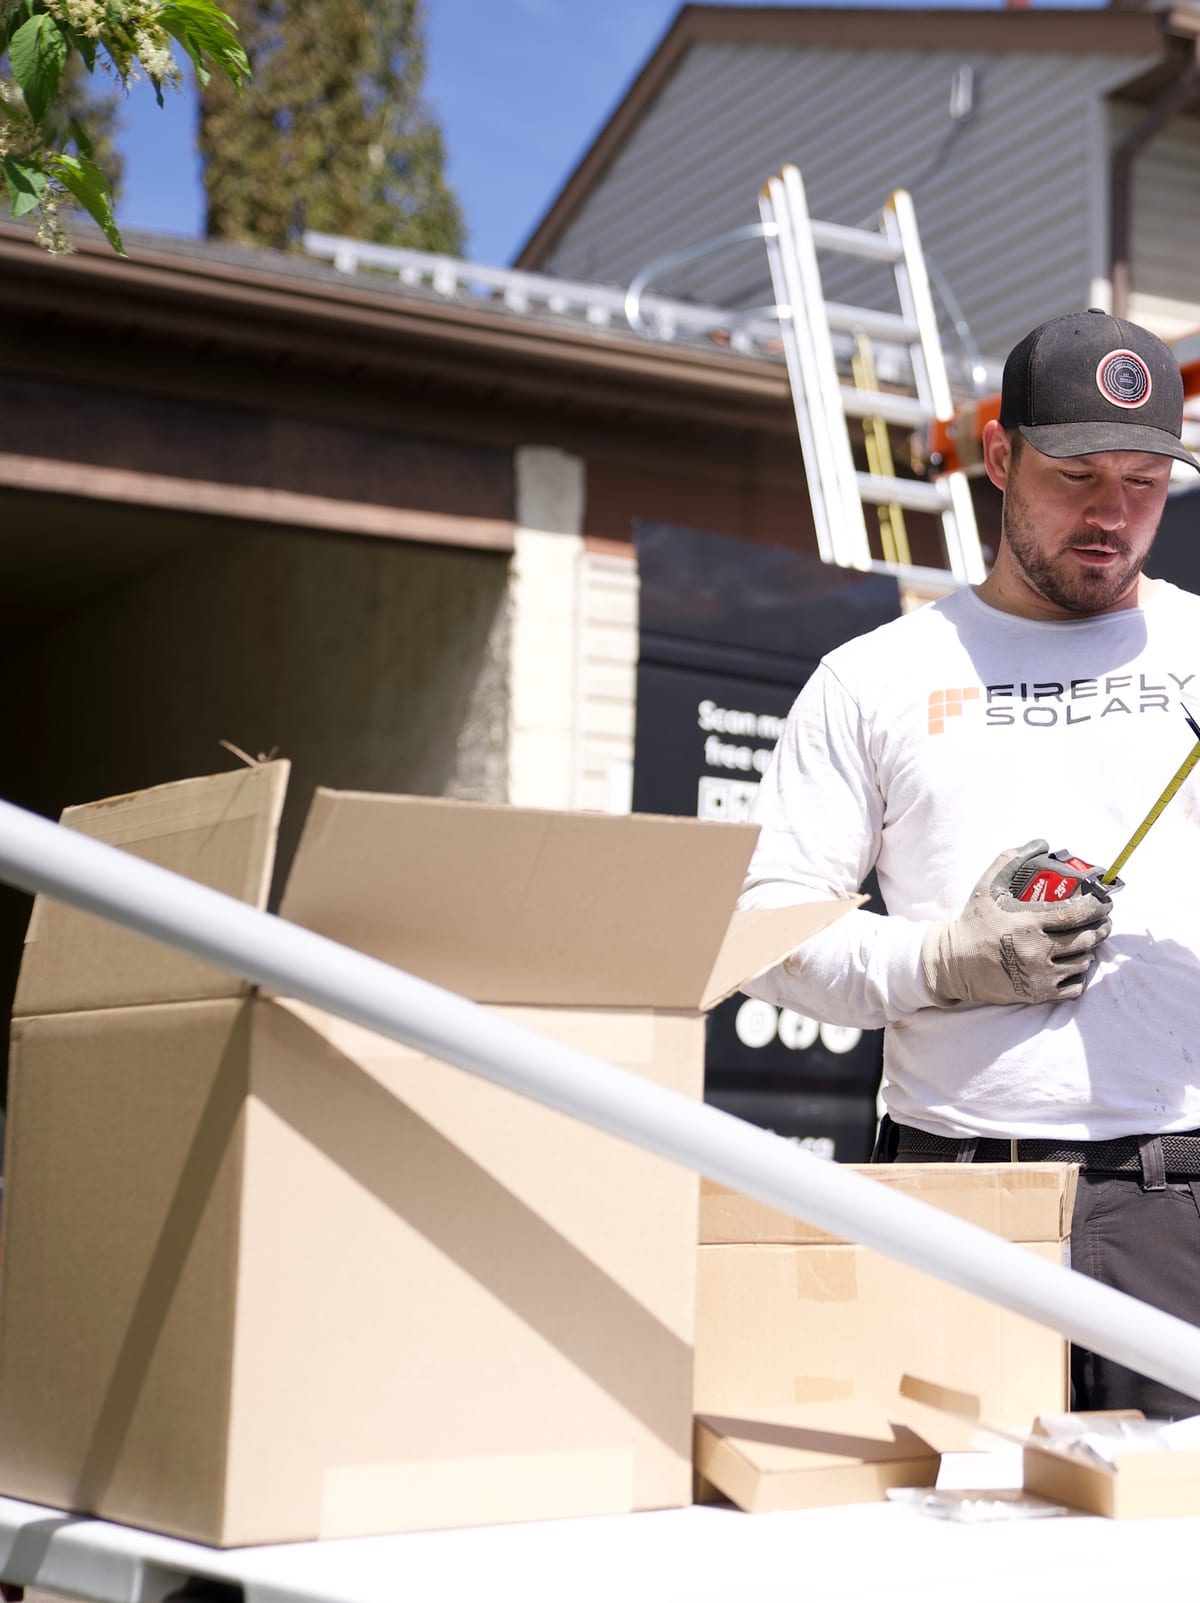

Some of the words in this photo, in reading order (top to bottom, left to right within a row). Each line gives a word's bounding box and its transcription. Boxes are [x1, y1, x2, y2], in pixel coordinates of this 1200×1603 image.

[986, 672, 1196, 704] FIREFLY
[698, 700, 757, 737] Scan
[985, 694, 1170, 728] SOLAR
[705, 736, 753, 771] free
